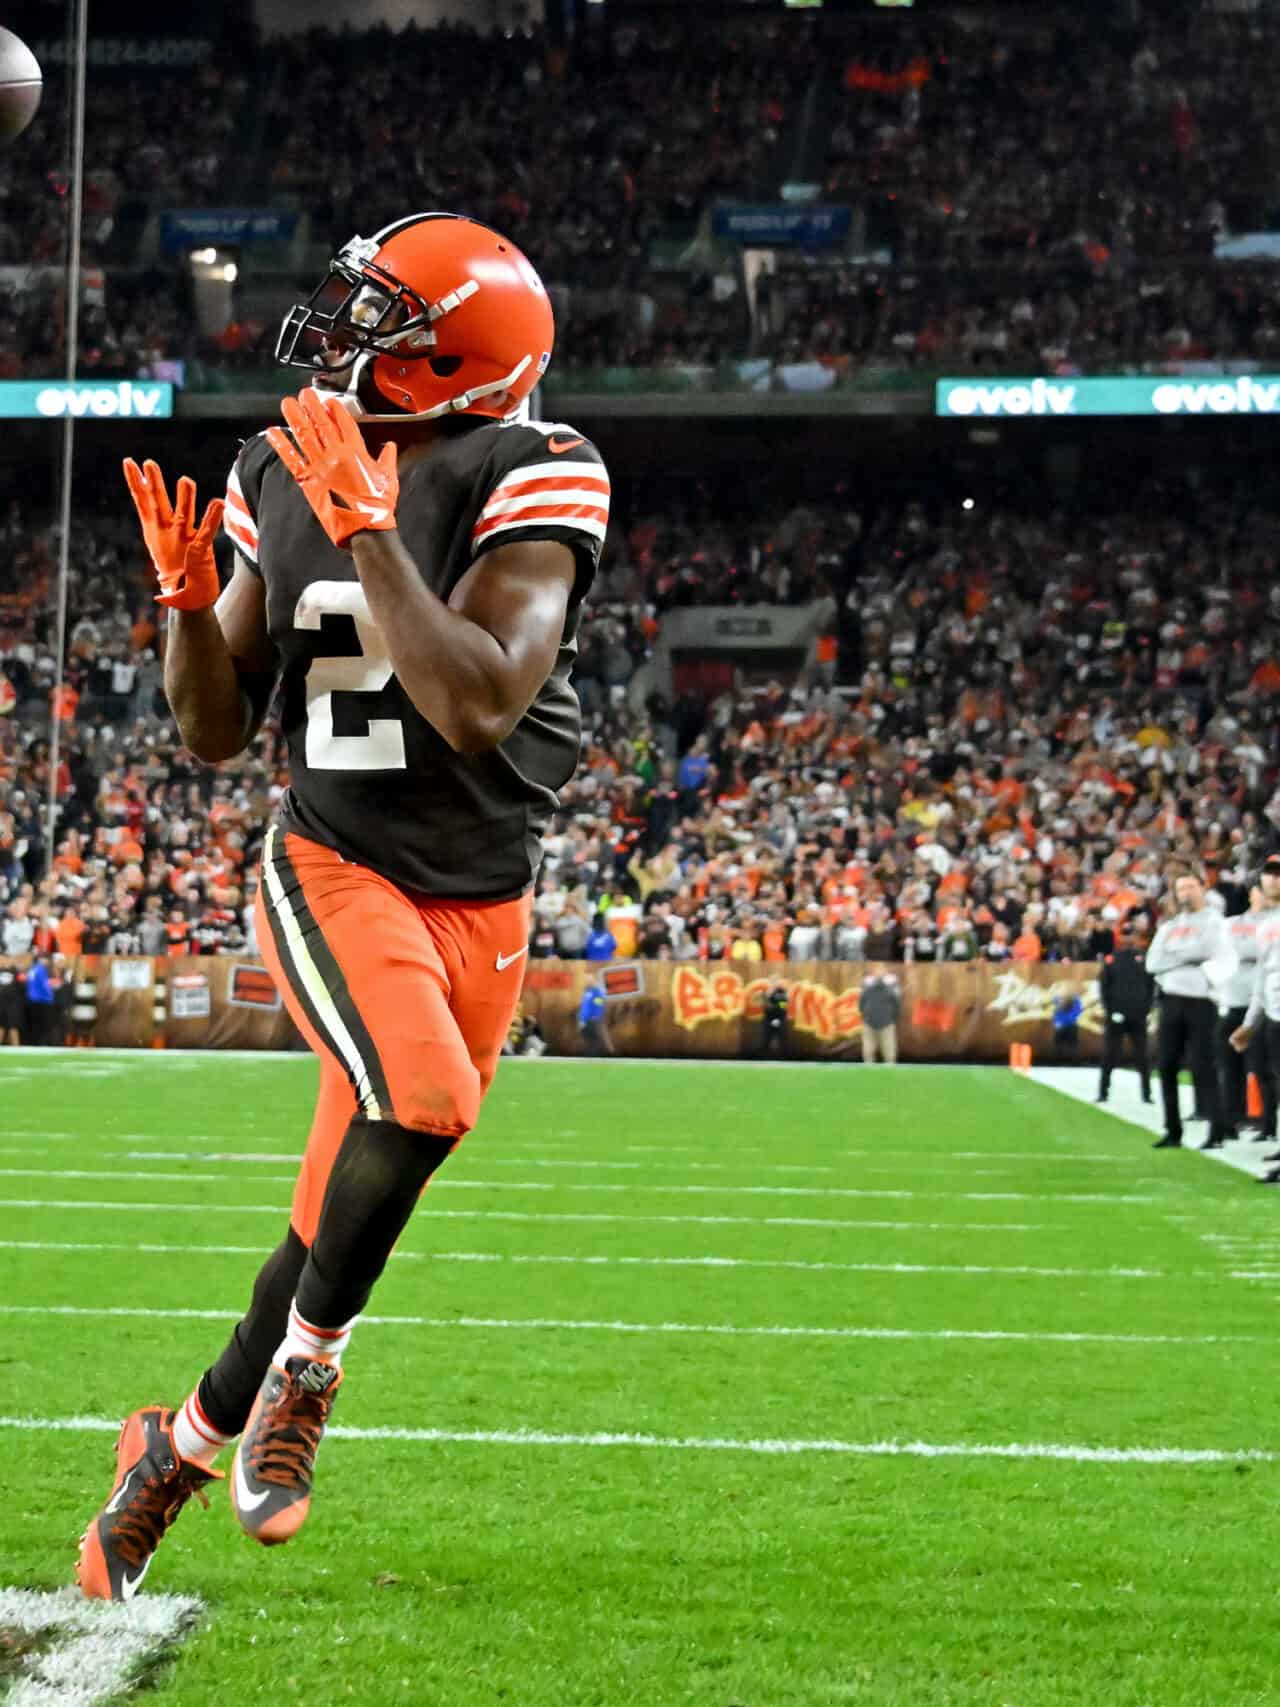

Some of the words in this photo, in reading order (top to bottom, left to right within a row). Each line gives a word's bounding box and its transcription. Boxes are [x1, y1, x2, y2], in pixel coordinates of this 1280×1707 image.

[35, 381, 160, 416] evolv
[947, 377, 1075, 414] evolv
[1151, 376, 1280, 413] evolv
[293, 580, 407, 769] 2
